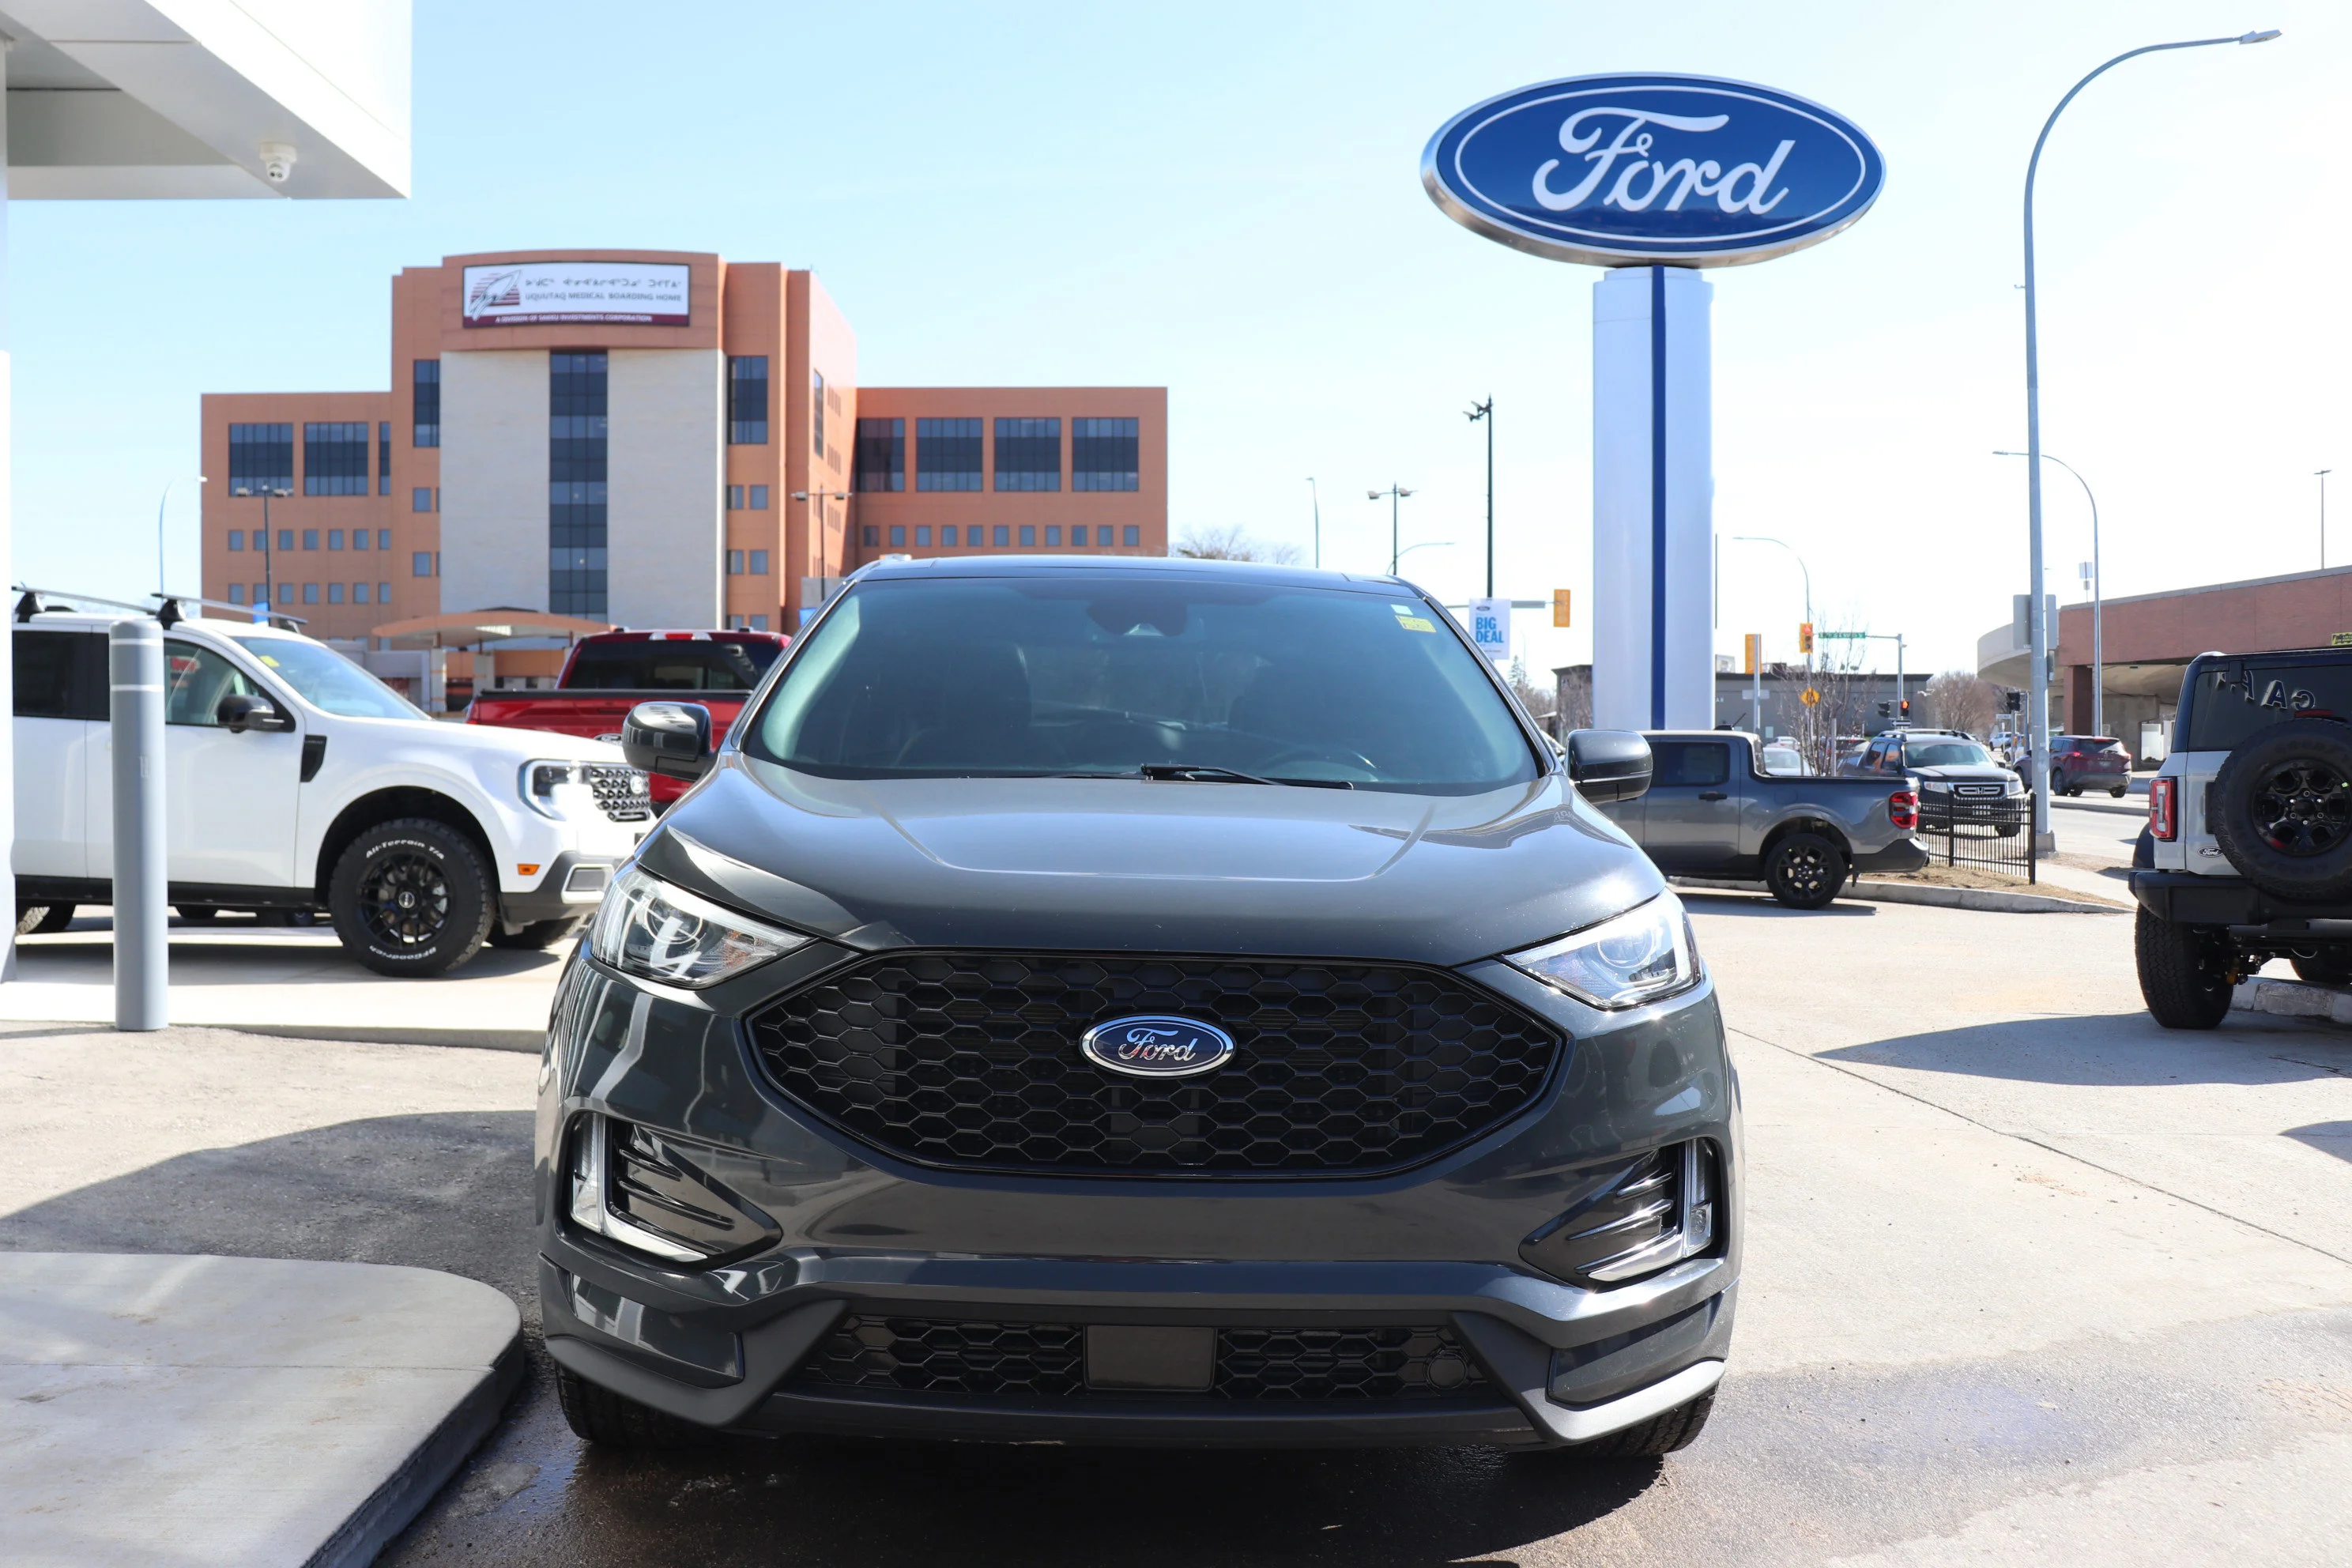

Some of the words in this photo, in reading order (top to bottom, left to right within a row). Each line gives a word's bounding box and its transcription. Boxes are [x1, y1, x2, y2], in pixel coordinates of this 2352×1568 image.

[1532, 106, 1796, 215] Ford
[608, 292, 654, 301] BOARDING
[656, 293, 682, 302] HOME
[1476, 616, 1497, 630] BIG
[1476, 630, 1504, 643] DEAL
[366, 839, 425, 858] All-Terrain
[1118, 1027, 1198, 1061] Ford
